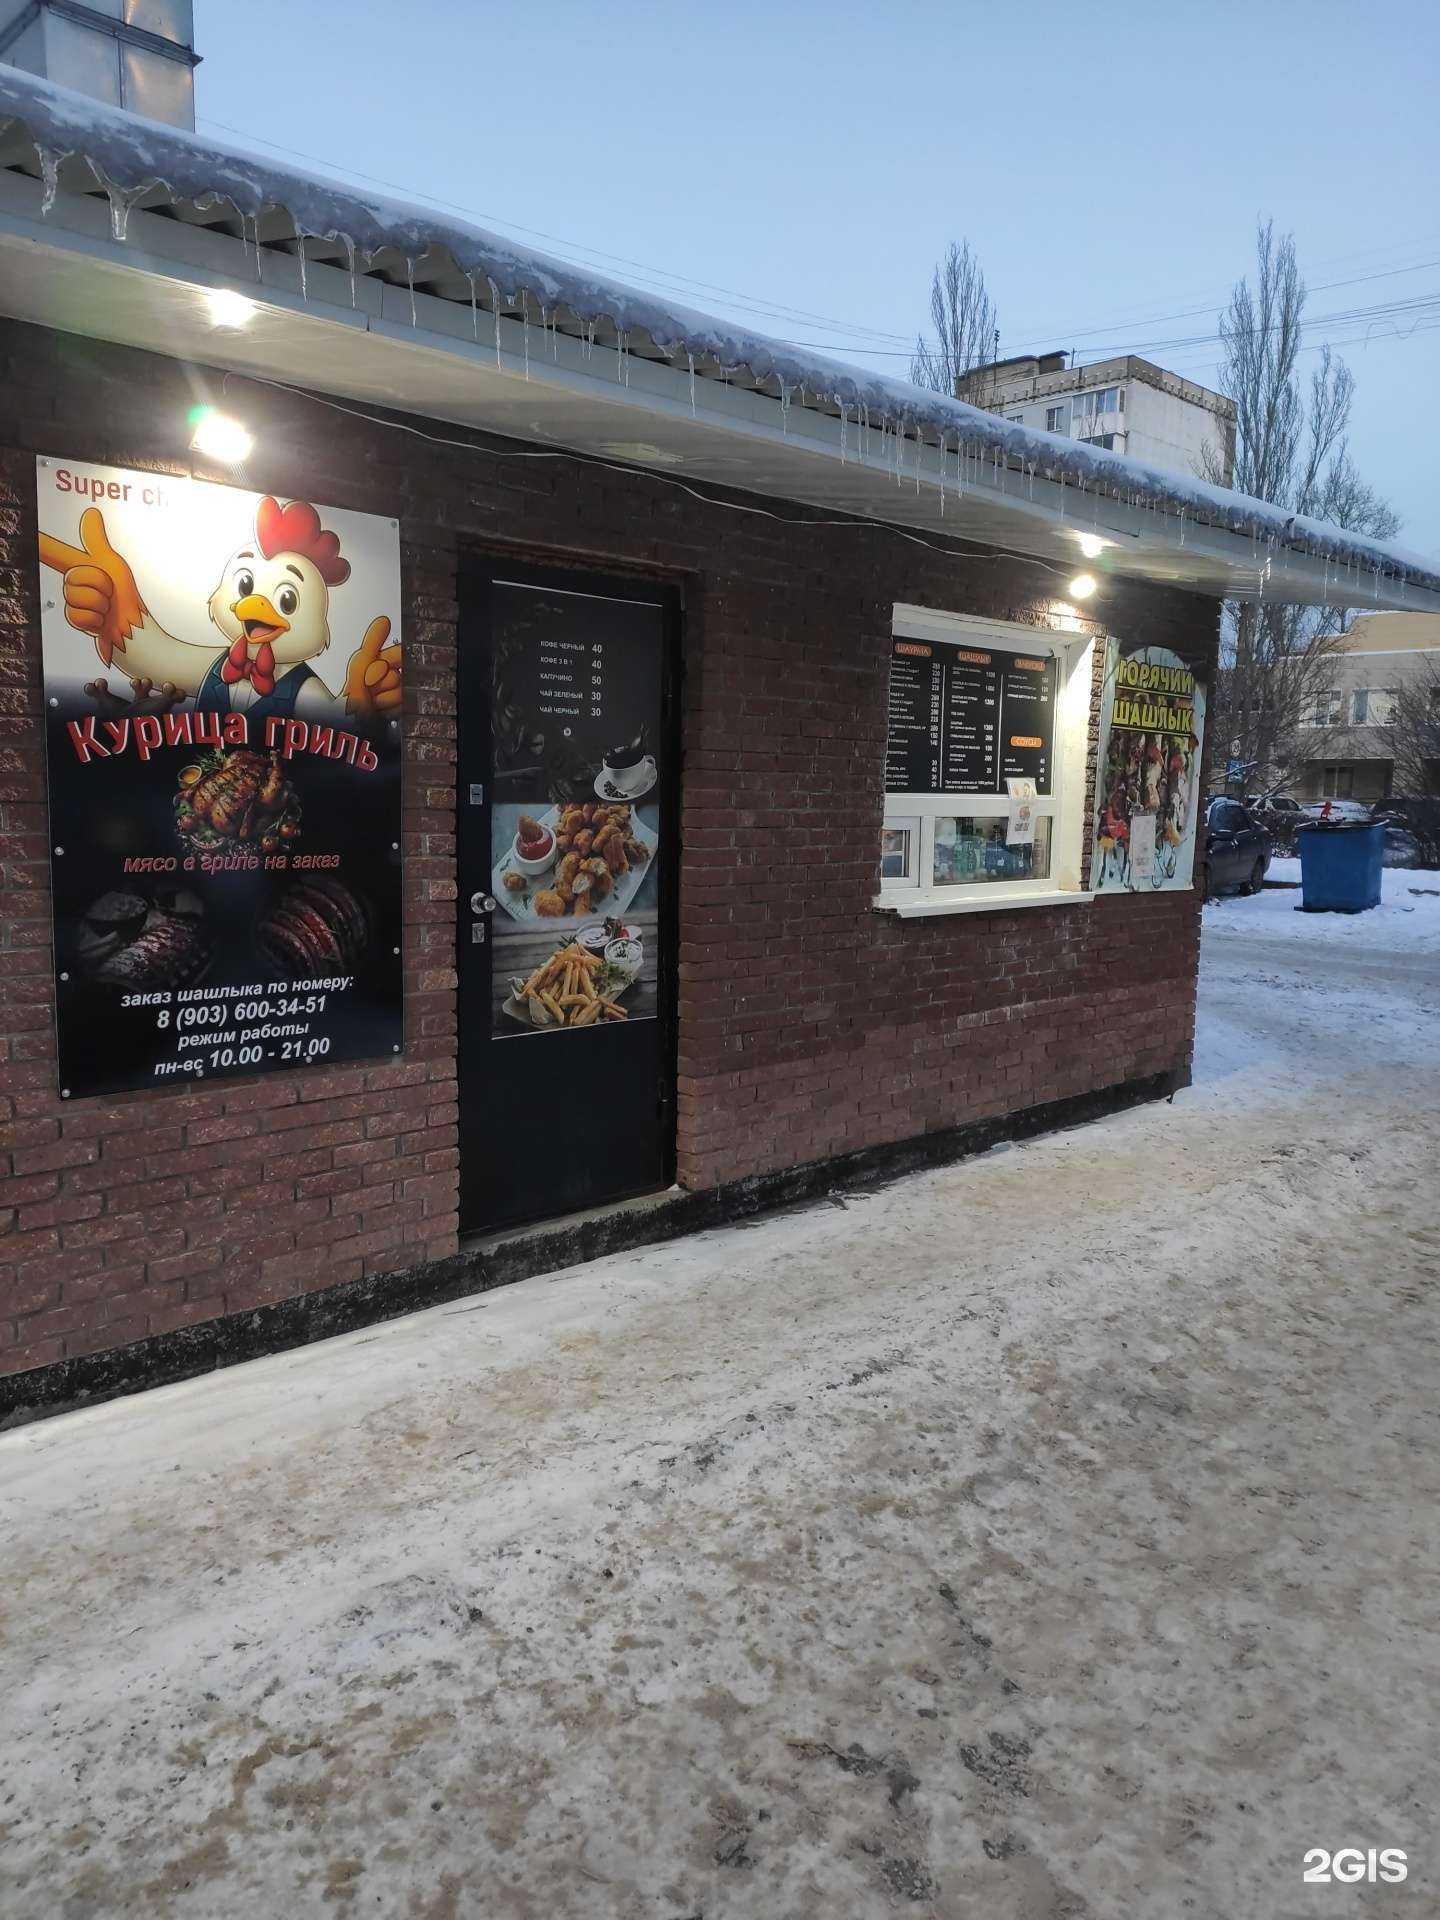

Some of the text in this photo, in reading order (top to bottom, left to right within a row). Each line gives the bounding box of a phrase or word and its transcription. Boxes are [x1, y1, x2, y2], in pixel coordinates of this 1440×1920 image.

[55, 469, 132, 502] Super
[540, 640, 602, 653] КОФЕ ЧЕРНЫЙ 40
[540, 656, 557, 664] КОФЕ
[592, 660, 602, 669] 40
[1118, 658, 1193, 694] ГОРЯЧИЙ
[540, 673, 602, 685] КАПУЧИНО 50
[540, 689, 601, 701] ЧАЙ ЗЕЛЕНЫЙ 30
[553, 707, 580, 715] ЧЕРНЫЙ
[591, 708, 601, 717] 30
[1113, 699, 1192, 732] ШАШЛЫК
[66, 711, 379, 772] Курица гриль
[123, 853, 341, 875] мясо в гриле на заказ
[120, 976, 354, 1007] заказ шашлыка по номеру:
[156, 995, 327, 1030] 8 (903) 600-34-51
[177, 1022, 309, 1051] режим работы
[154, 1058, 204, 1076] пн-вс
[209, 1045, 263, 1069] 10.00
[281, 1037, 330, 1061] 21.00
